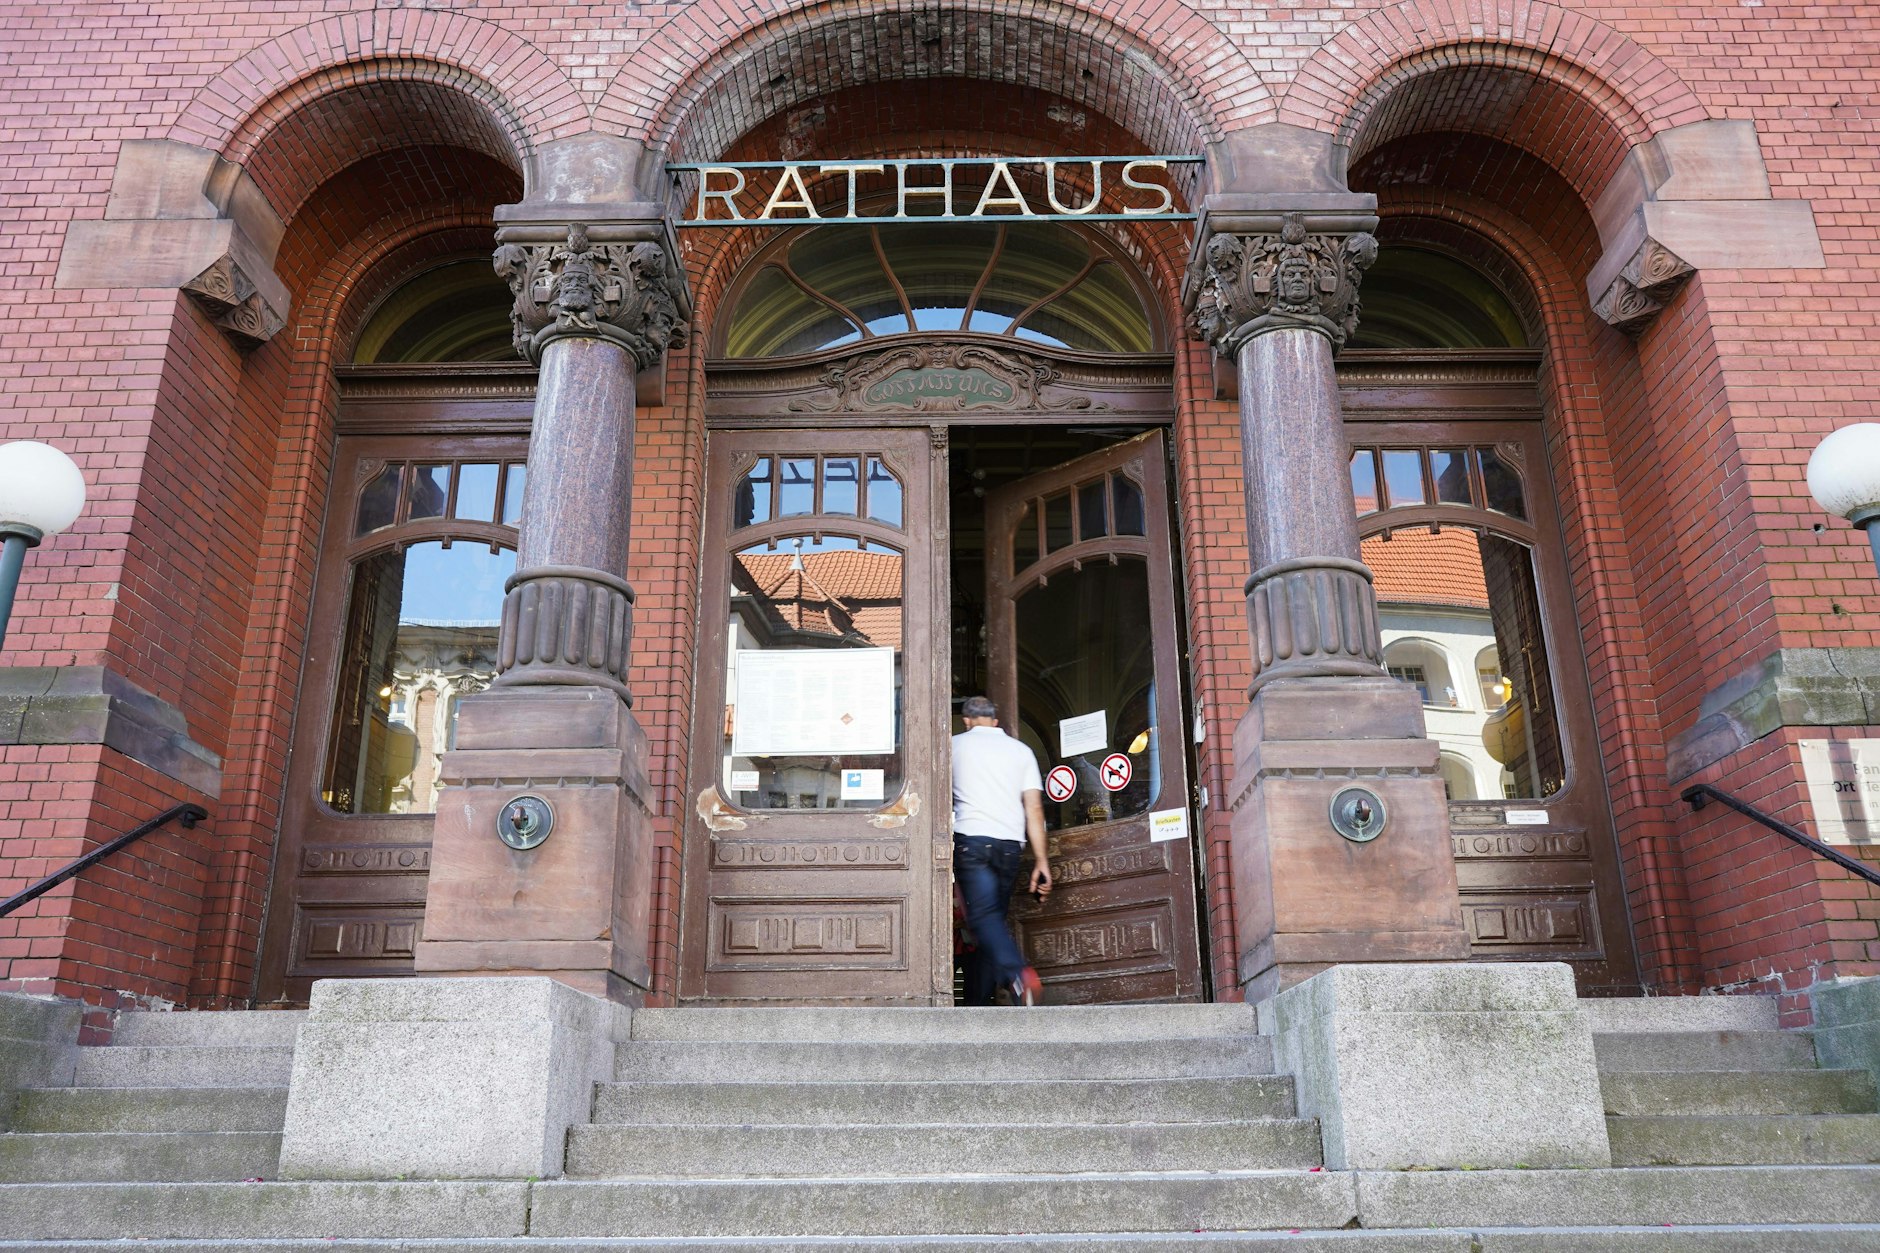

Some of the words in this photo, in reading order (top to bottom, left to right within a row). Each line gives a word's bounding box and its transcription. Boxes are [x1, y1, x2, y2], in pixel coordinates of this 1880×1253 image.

[695, 160, 1175, 221] RATHAUS
[870, 376, 917, 402] GOTT
[918, 373, 956, 391] MIT
[1833, 780, 1857, 793] Ort
